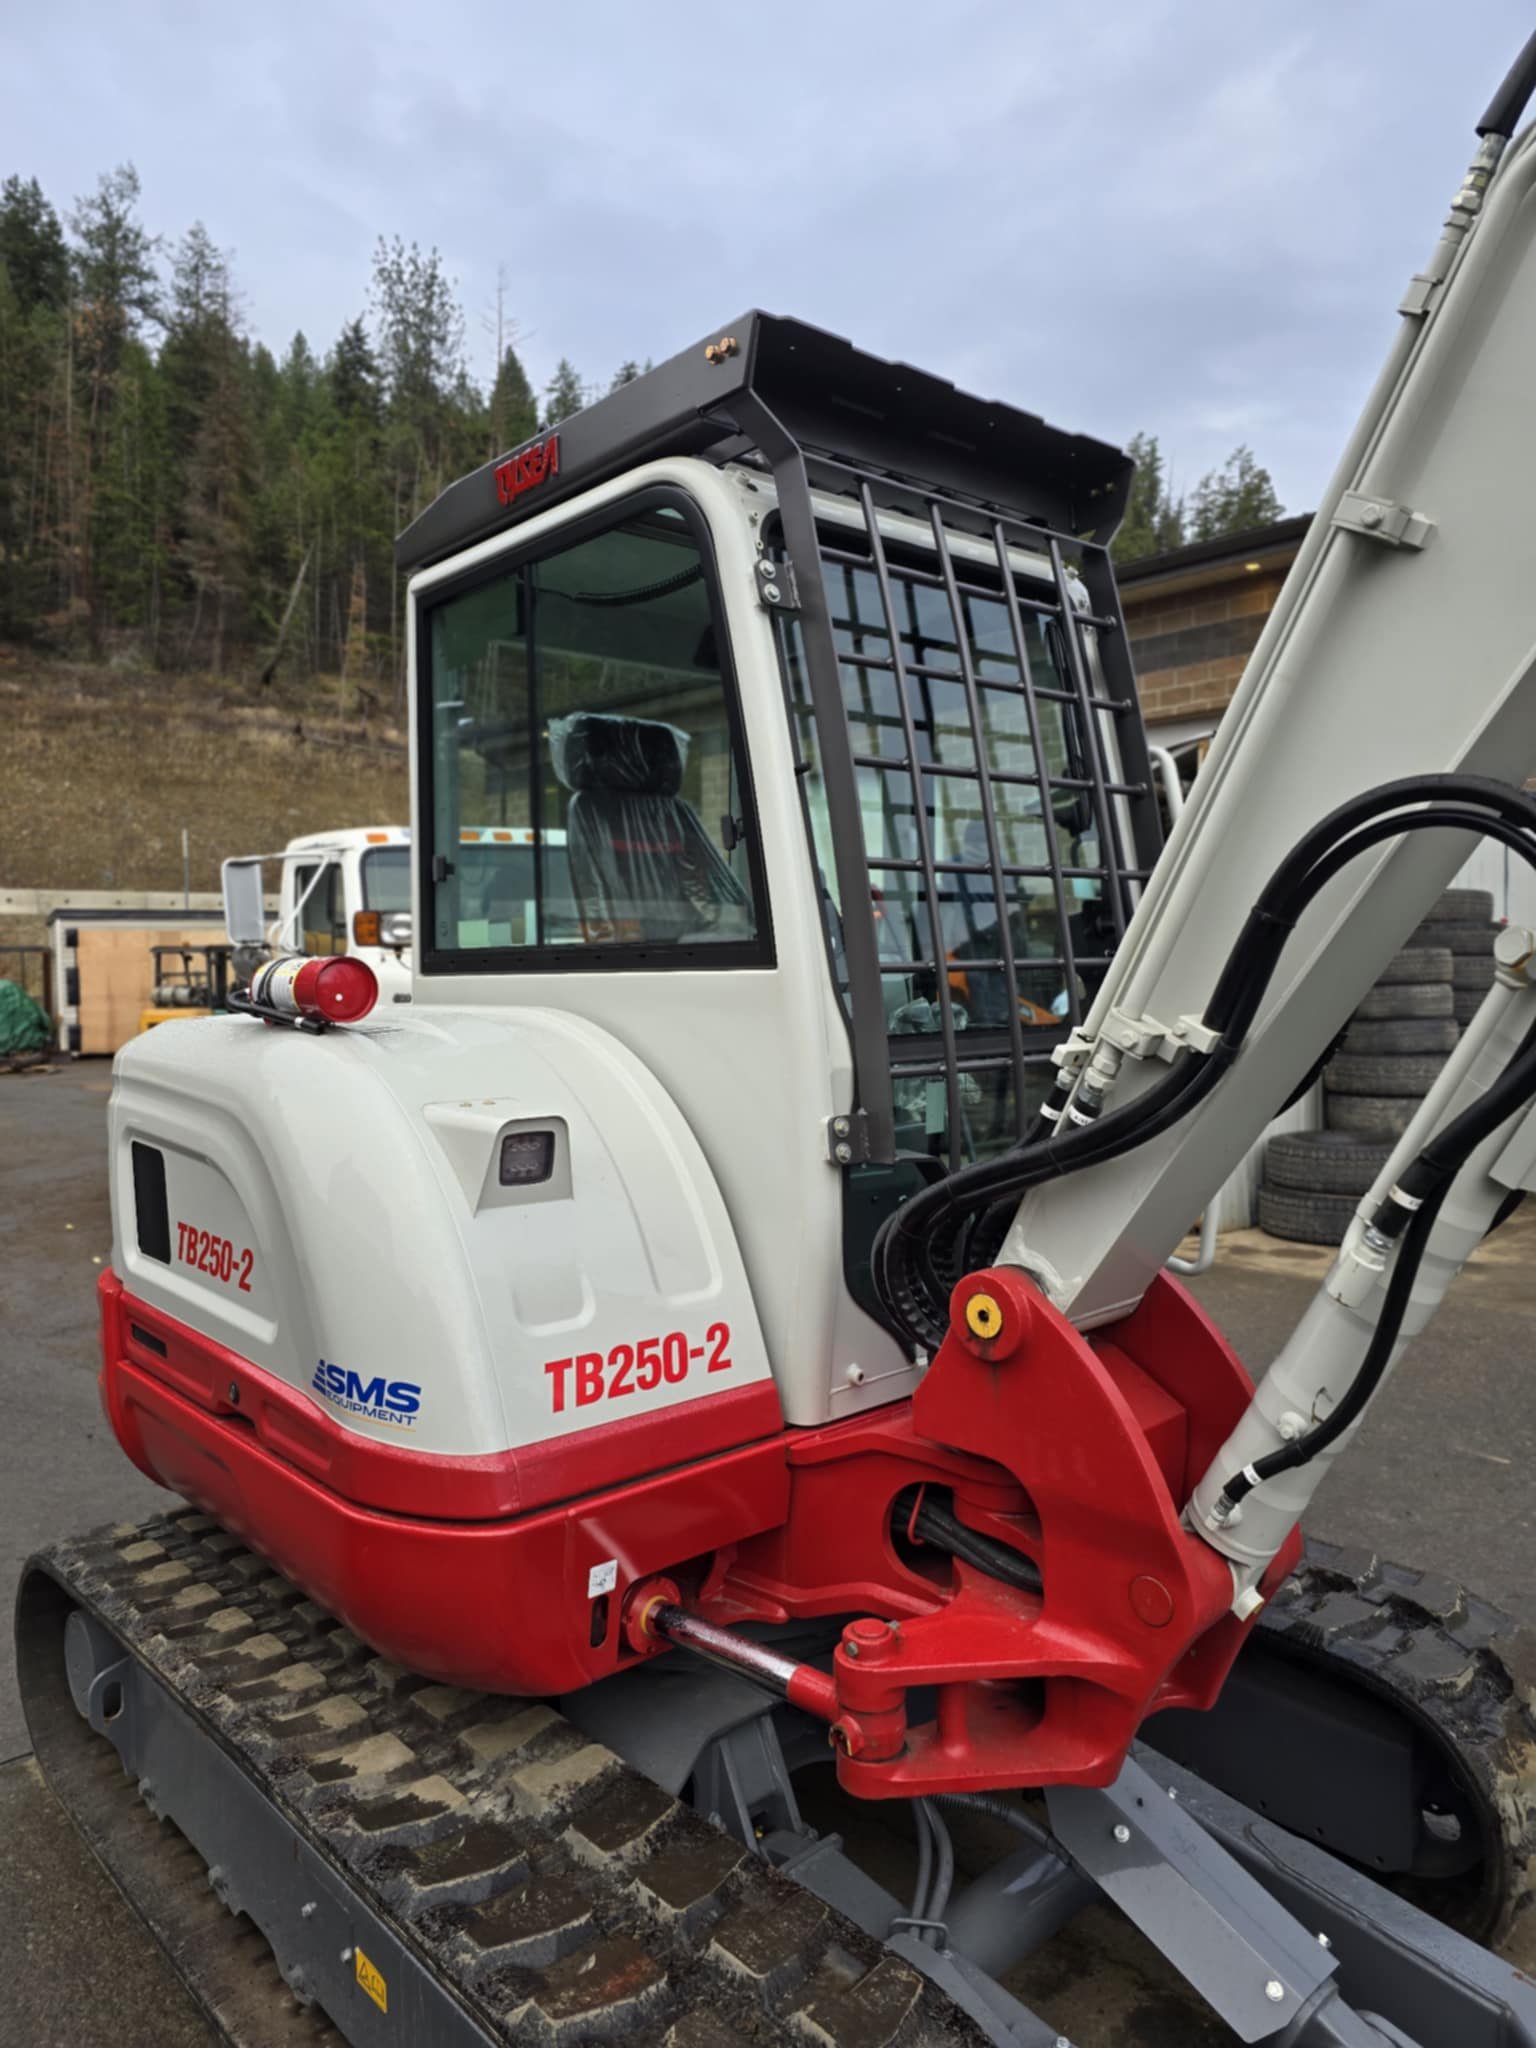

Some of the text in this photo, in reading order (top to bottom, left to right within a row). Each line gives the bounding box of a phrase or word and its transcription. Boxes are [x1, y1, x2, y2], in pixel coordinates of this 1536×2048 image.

[177, 1221, 254, 1293] TB250-2
[326, 1363, 421, 1413] SMS
[544, 1322, 732, 1413] TB250-2
[324, 1390, 417, 1426] EQUIPMENT
